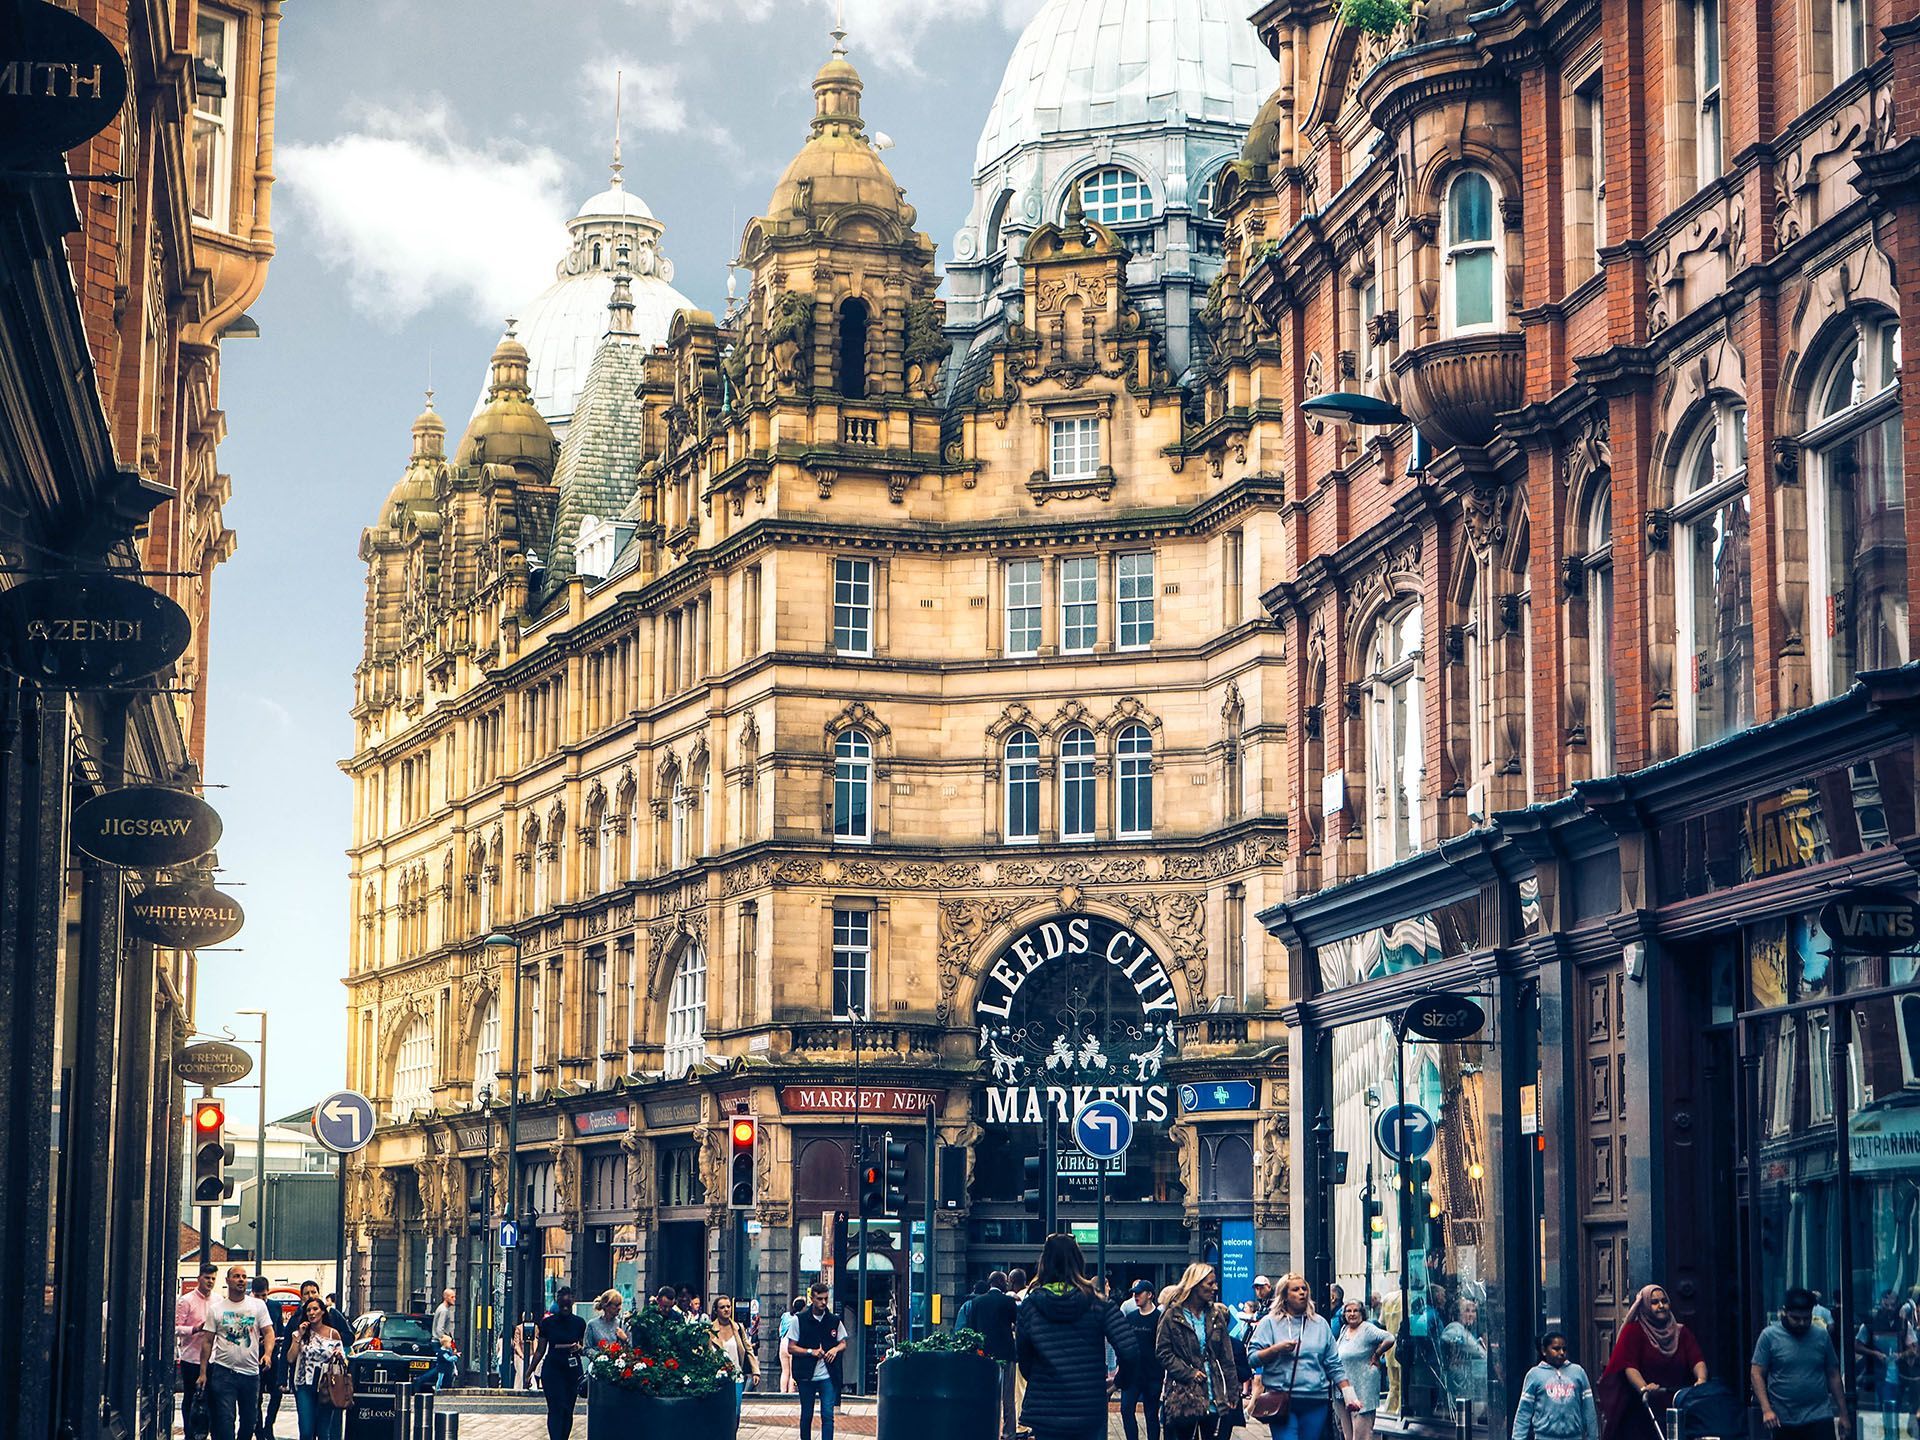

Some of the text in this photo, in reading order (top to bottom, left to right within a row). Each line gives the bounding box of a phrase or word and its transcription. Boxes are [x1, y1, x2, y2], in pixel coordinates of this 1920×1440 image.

[27, 619, 142, 641] AZENDI
[101, 818, 192, 836] JIGSAW
[1745, 788, 1816, 875] VANS
[133, 905, 237, 921] WHITEWALL
[1836, 904, 1916, 937] VANS
[977, 918, 1178, 1020] LEEDS CITY
[1422, 1009, 1468, 1027] size?
[191, 1053, 233, 1063] FRENCH
[178, 1063, 245, 1074] CONNECTION
[800, 1090, 937, 1110] MARKET NEWS
[1069, 1177, 1099, 1185] MARK
[1223, 1238, 1253, 1246] welcome
[370, 1409, 396, 1417] Leeds
